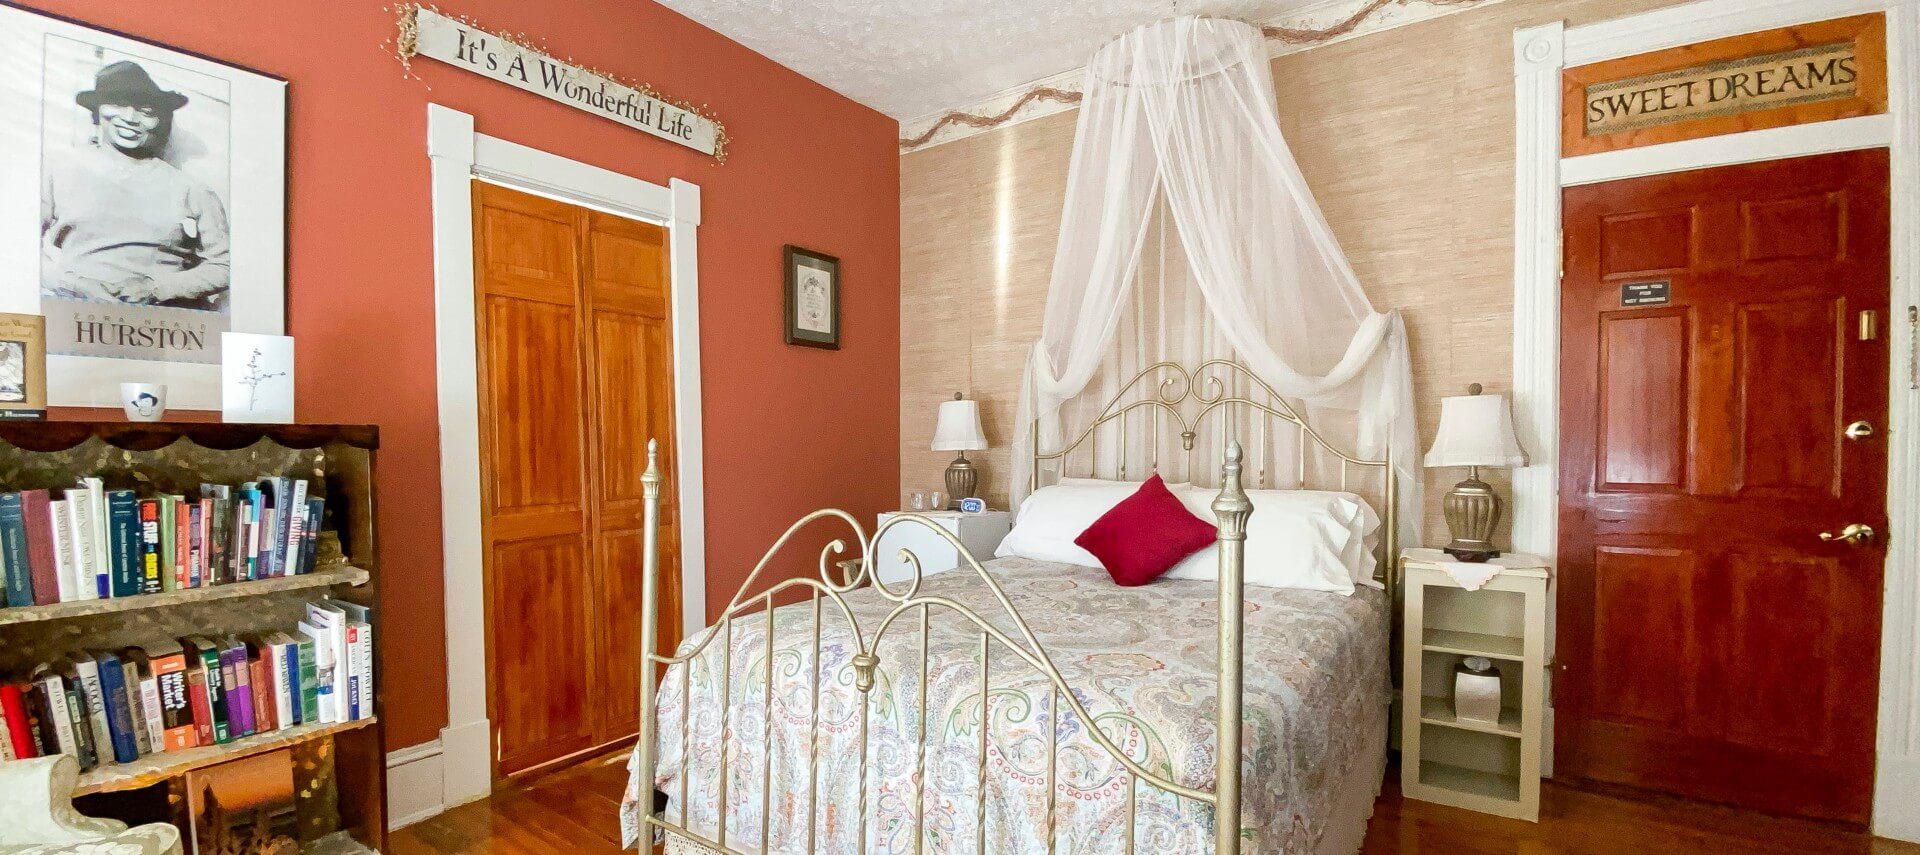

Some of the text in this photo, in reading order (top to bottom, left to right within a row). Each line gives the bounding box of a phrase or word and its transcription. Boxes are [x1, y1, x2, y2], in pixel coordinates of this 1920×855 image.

[457, 29, 693, 140] It's A Wonderful Life
[1589, 56, 1857, 123] SWEET DREAMS
[76, 321, 204, 351] HURSTON
[290, 516, 302, 547] GIVING
[160, 674, 176, 710] Market
[172, 671, 187, 708] Writer's
